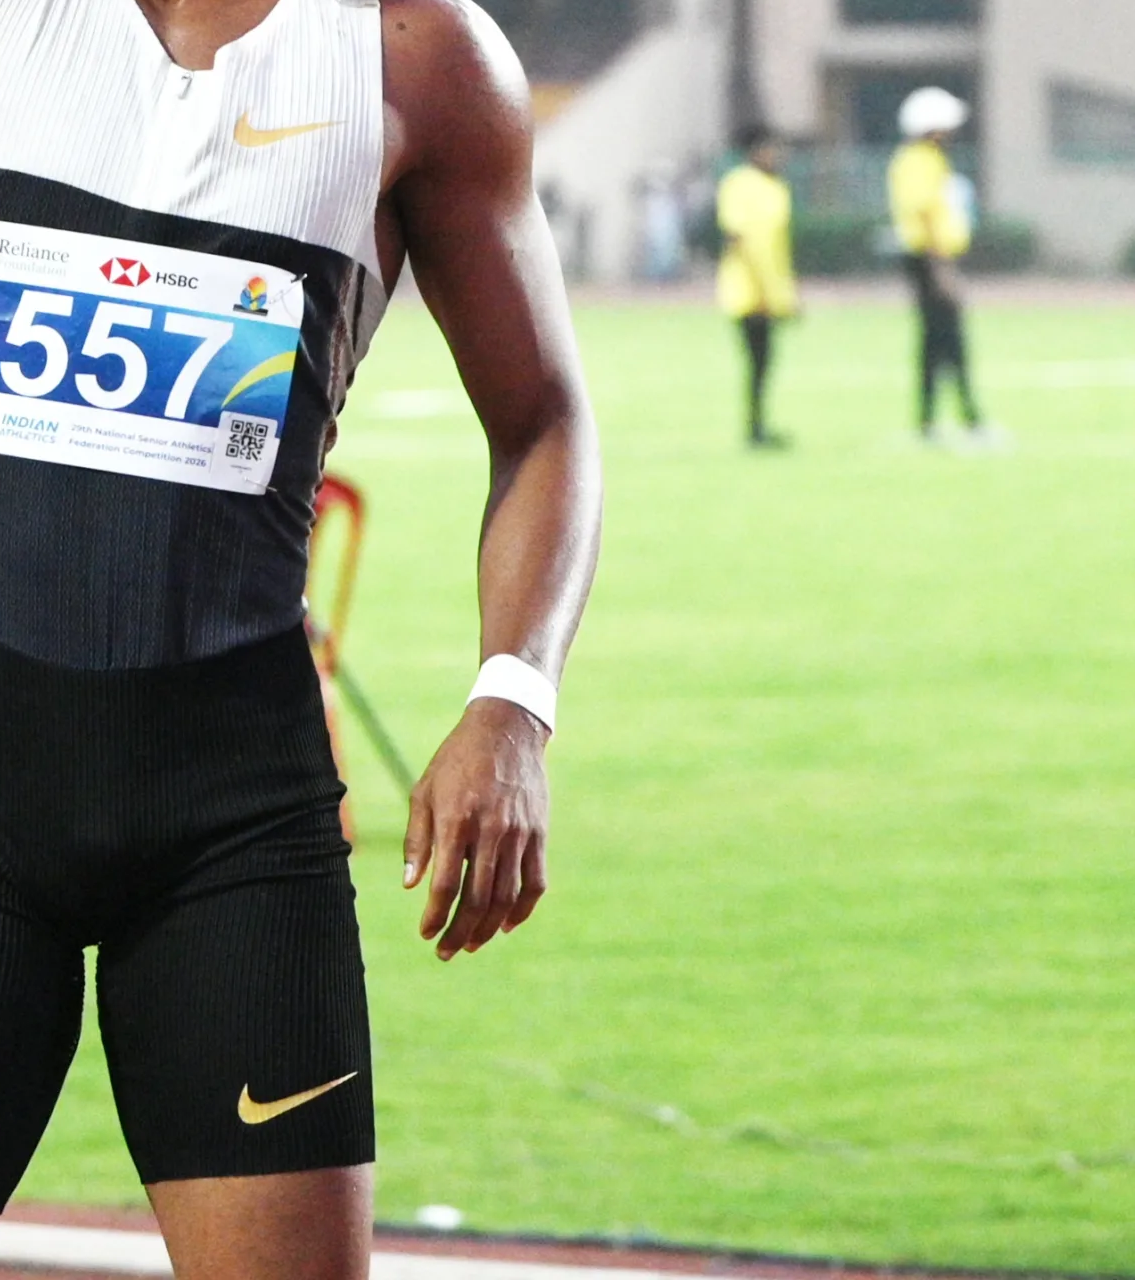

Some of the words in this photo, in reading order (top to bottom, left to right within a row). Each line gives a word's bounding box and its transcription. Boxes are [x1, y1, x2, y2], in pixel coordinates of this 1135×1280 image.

[155, 271, 199, 290] HSBC
[0, 289, 234, 420] 557
[1, 413, 59, 433] INDIAN
[69, 438, 121, 453] Federation
[123, 446, 183, 463] Competition
[184, 455, 207, 468] 2026
[71, 423, 92, 435] 29th
[94, 427, 136, 440] National
[138, 434, 168, 446] Senior
[170, 439, 213, 454] Athletics
